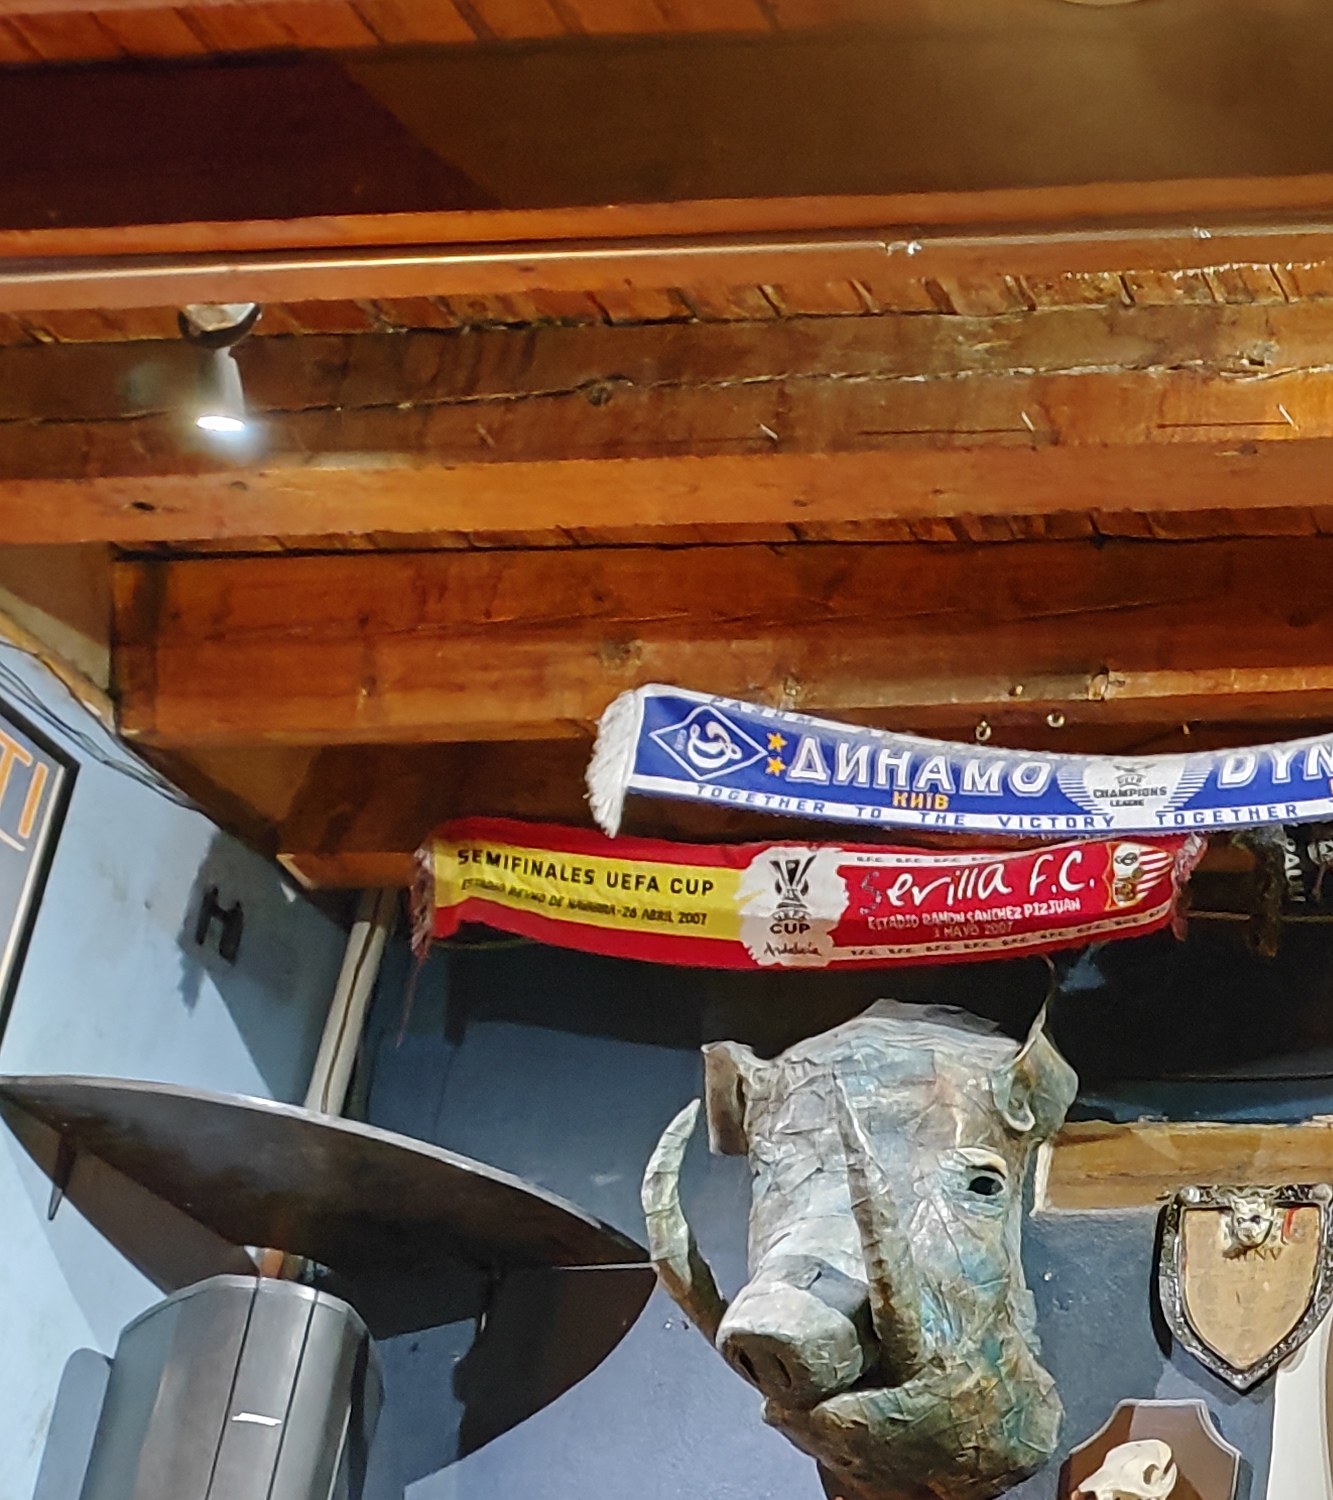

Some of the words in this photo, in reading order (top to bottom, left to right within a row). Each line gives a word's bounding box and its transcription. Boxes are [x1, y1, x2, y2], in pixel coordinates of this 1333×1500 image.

[787, 736, 1052, 797] ДИНАМО
[698, 785, 826, 816] TOGETHER
[857, 806, 882, 820] TO
[919, 812, 966, 827] THE
[998, 814, 1115, 830] VICTORY
[1093, 786, 1169, 800] CHAMPIONS
[1156, 803, 1298, 826] TOGETHER
[457, 849, 596, 886] SEMIFINALES
[606, 871, 660, 893] UEFA
[670, 878, 715, 896] CUP
[859, 863, 1012, 915] Sevilla
[1028, 850, 1096, 897] F.C.
[678, 911, 708, 926] 2007
[769, 922, 812, 935] CUP
